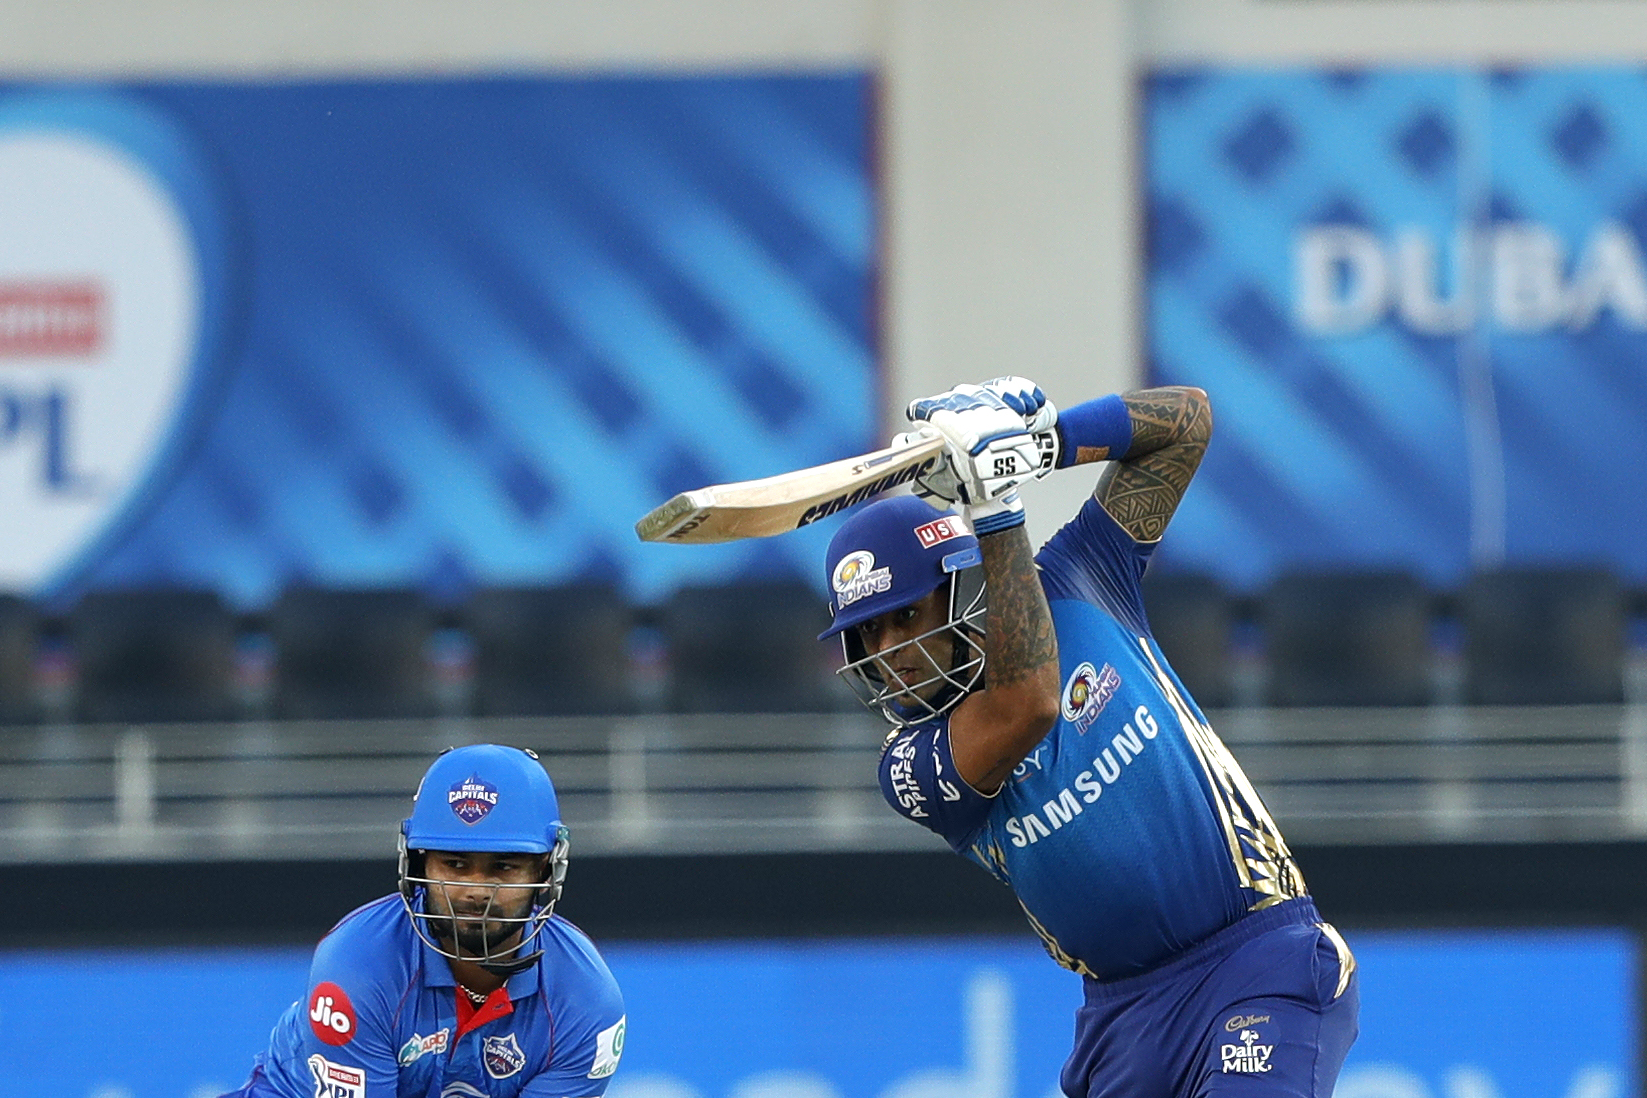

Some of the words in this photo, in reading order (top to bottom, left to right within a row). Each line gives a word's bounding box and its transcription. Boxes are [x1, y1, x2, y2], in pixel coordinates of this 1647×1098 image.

[994, 456, 1015, 476] SS
[1006, 705, 1158, 848] SAMSUNG
[448, 791, 498, 805] CAPITALS
[310, 996, 350, 1034] Jio
[1221, 1044, 1273, 1061] Dairy
